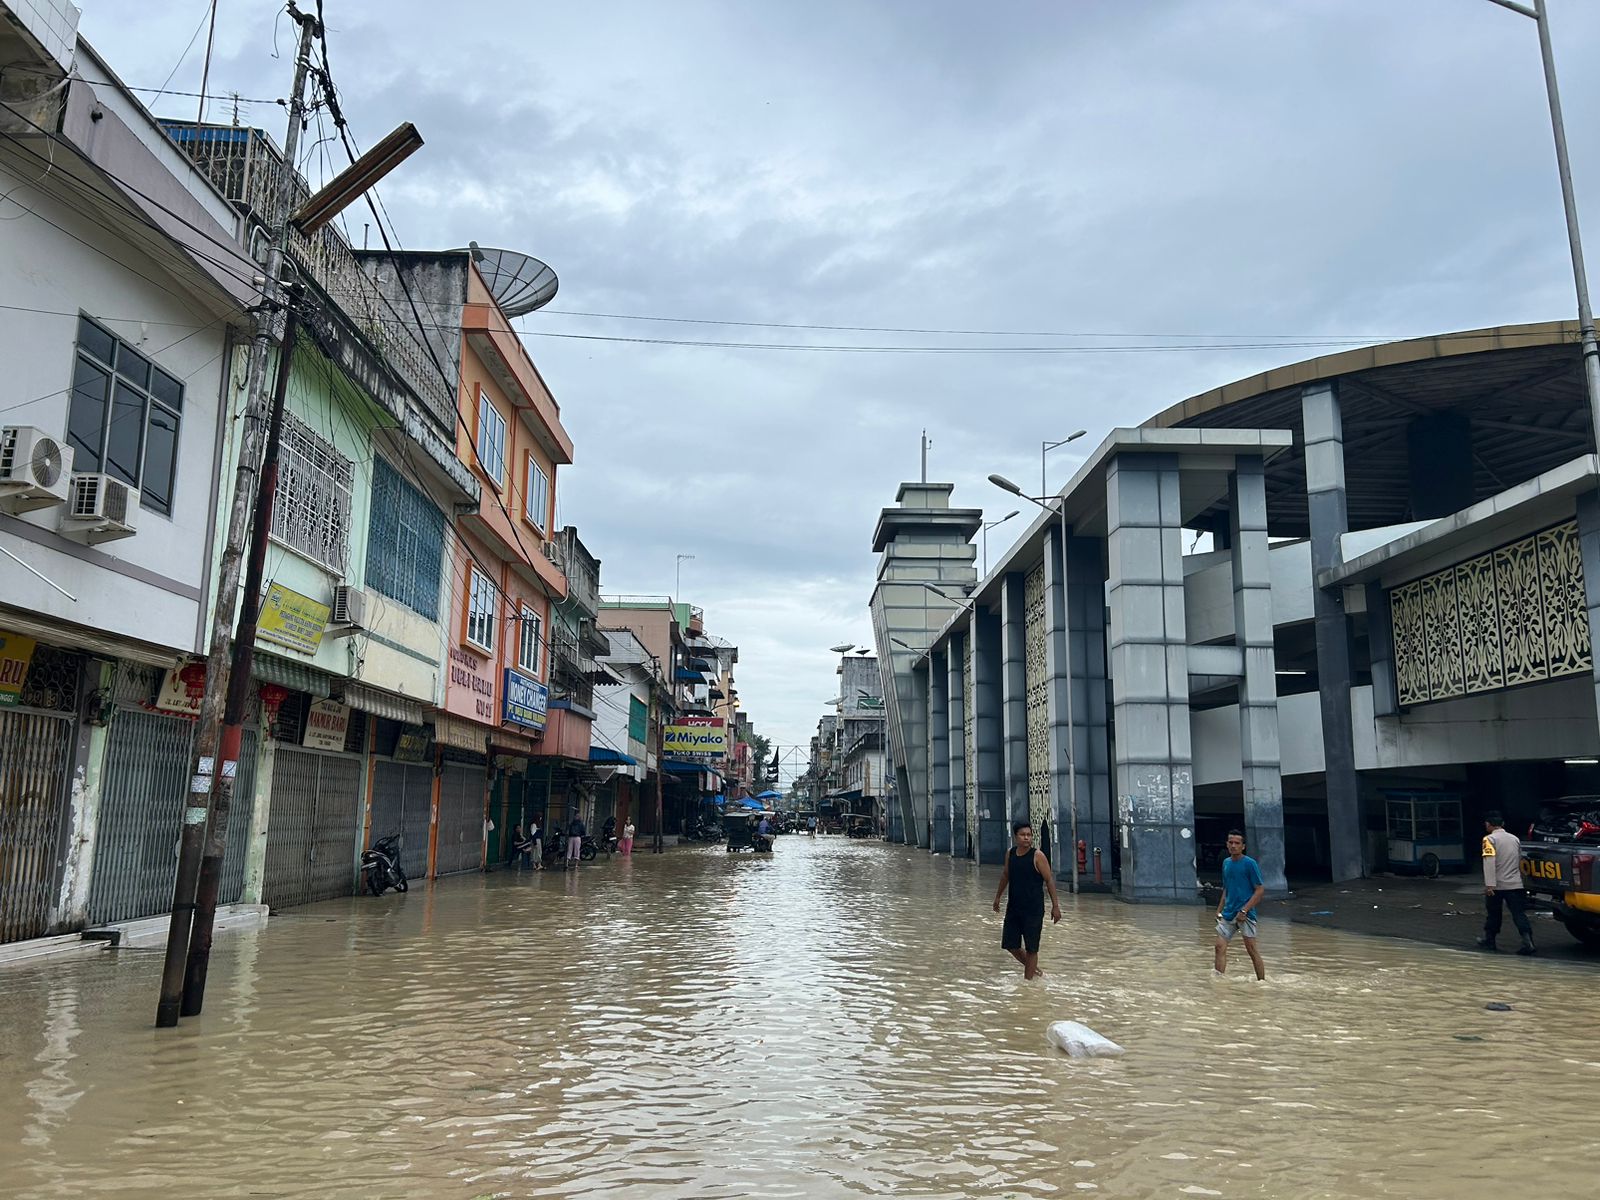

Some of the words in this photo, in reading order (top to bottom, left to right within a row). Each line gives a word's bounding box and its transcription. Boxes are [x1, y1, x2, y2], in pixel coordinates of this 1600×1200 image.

[510, 680, 527, 706] MONEY
[526, 688, 547, 713] CHANGER
[309, 710, 332, 730] MAKMUR
[332, 714, 347, 733] BARU
[677, 732, 723, 746] Miyako
[1520, 858, 1562, 880] OLISI
